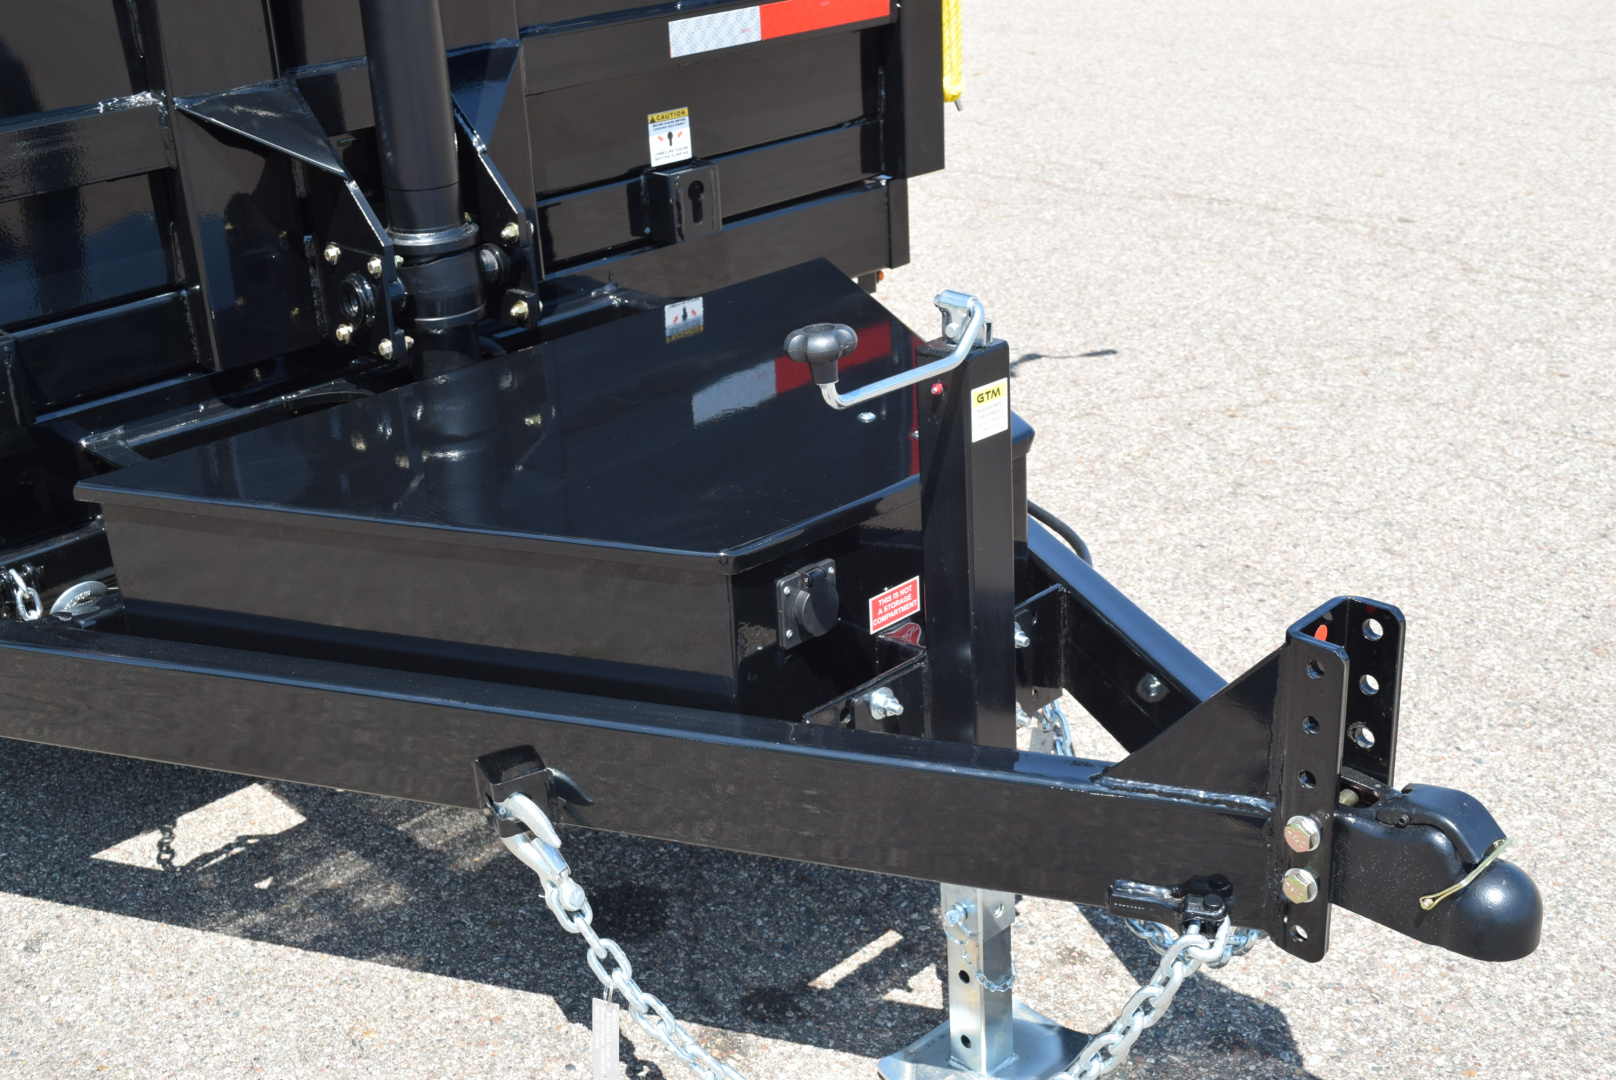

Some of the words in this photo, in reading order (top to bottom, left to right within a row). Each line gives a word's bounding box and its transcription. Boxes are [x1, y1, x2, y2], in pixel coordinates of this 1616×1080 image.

[656, 110, 686, 120] CAUTION
[976, 387, 1001, 404] GTM
[878, 595, 892, 606] THIS
[893, 591, 899, 600] IS
[900, 585, 912, 596] NOT
[878, 608, 883, 616] A
[884, 594, 912, 612] STORAGE
[872, 599, 918, 626] COMPARTMENT
